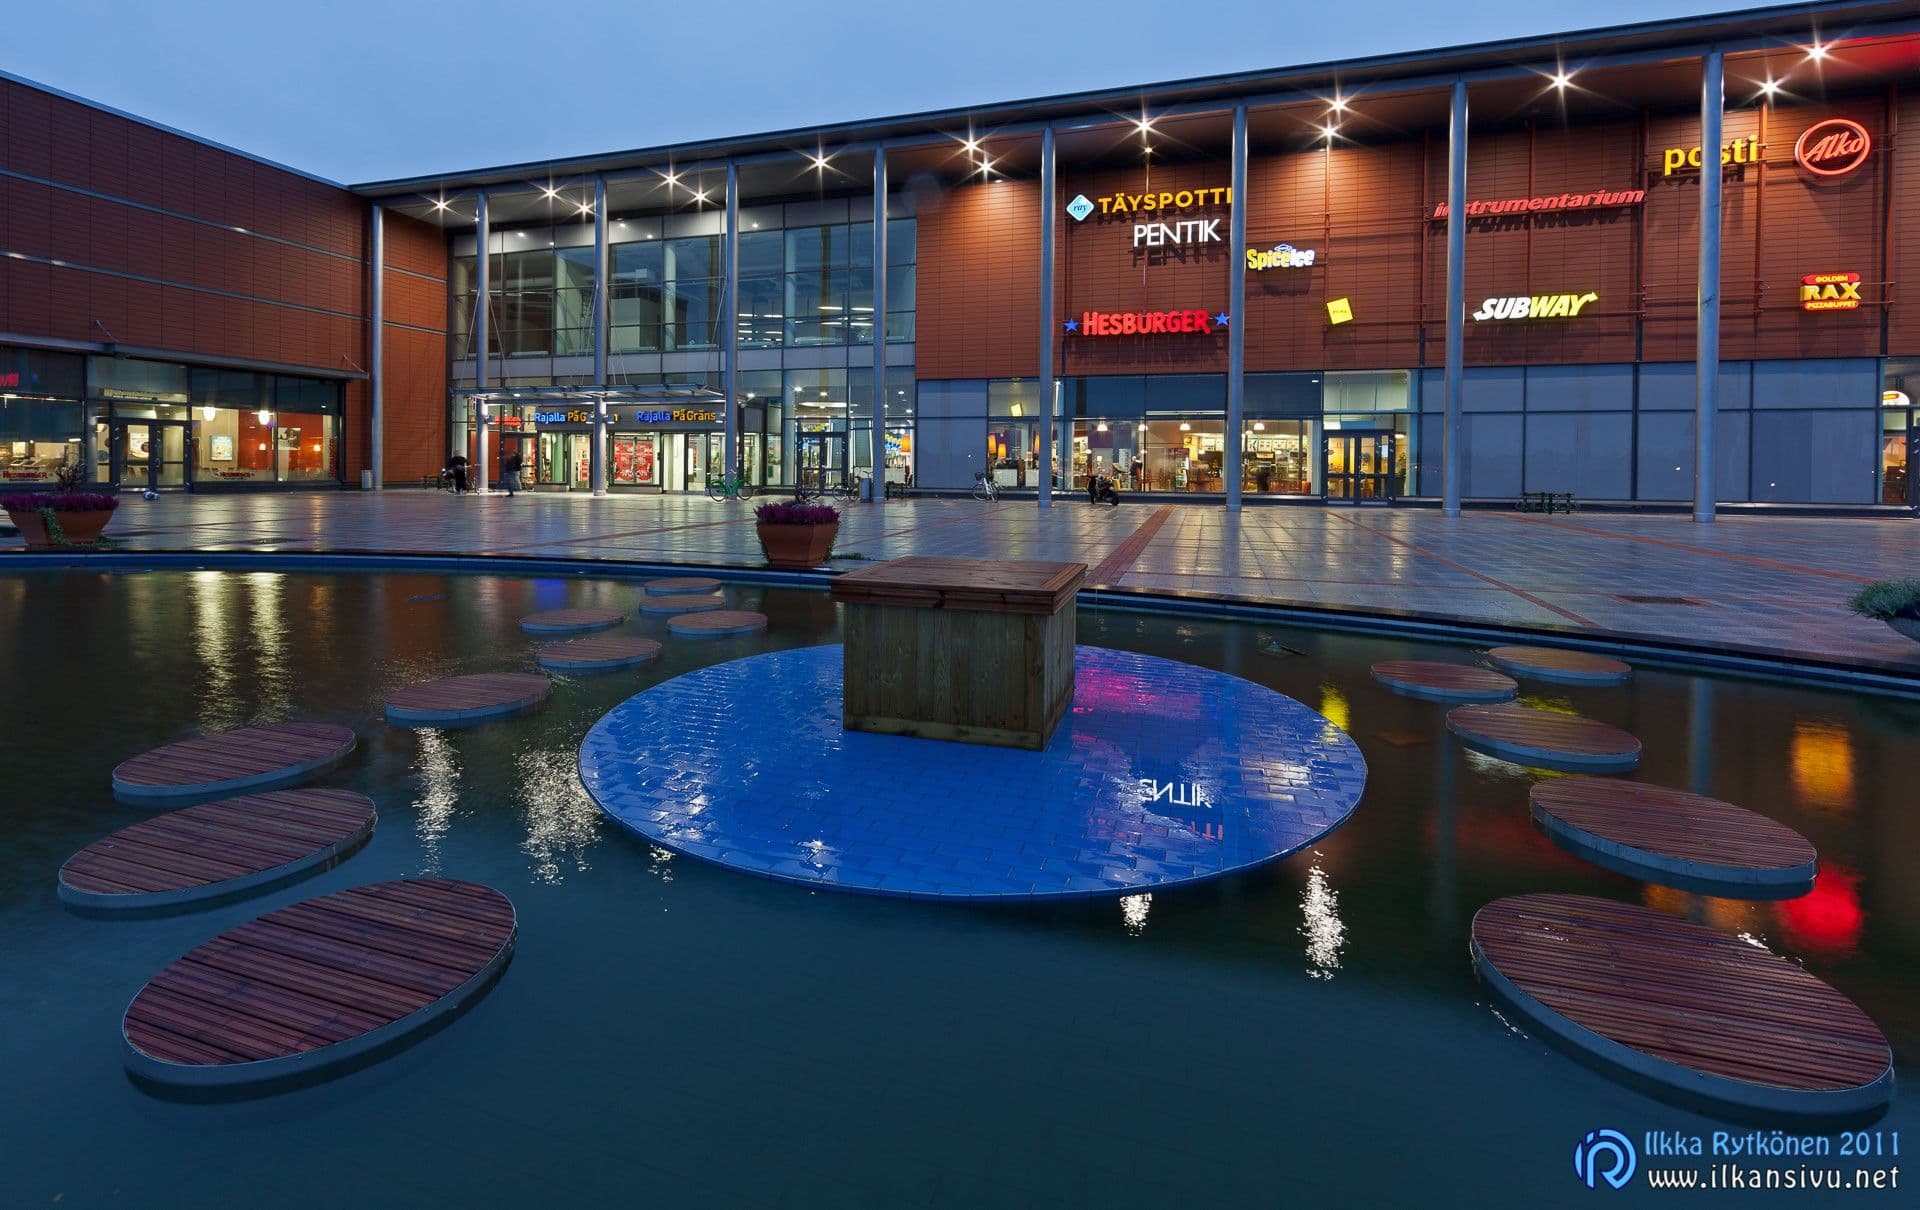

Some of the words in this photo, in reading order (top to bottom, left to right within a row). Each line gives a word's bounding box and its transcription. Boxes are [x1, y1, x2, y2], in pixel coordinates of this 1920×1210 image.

[1803, 131, 1865, 162] Alko
[1073, 203, 1087, 212] ray
[1098, 188, 1232, 214] TÄYSPOTTI
[1133, 219, 1221, 247] PENTIK
[1815, 275, 1848, 283] GOLDEN
[1801, 282, 1861, 300] RAX
[1473, 292, 1598, 321] SUBWAY
[1807, 300, 1858, 309] PIZZABUFFET
[1083, 310, 1211, 336] HESBURGER
[534, 411, 566, 424] Rajalla
[637, 410, 671, 423] Rajalla
